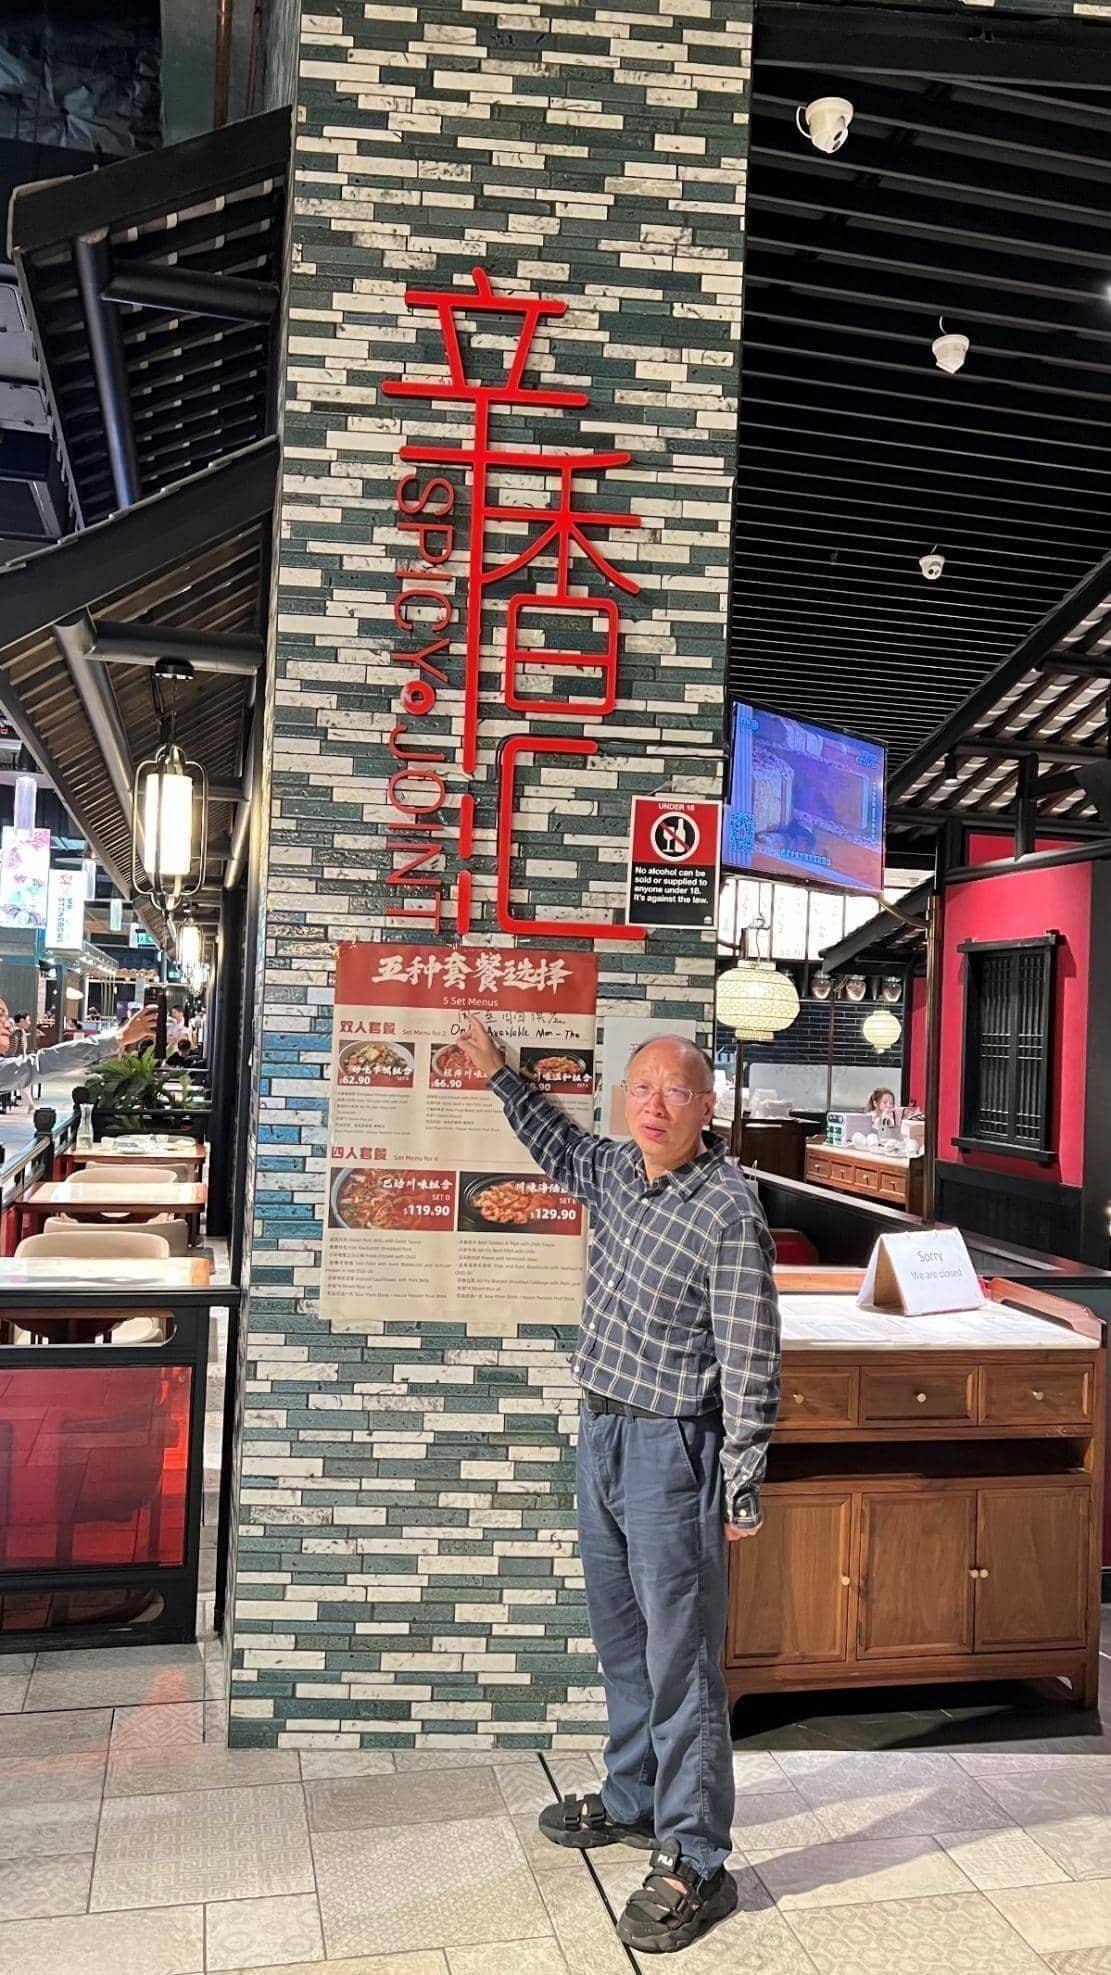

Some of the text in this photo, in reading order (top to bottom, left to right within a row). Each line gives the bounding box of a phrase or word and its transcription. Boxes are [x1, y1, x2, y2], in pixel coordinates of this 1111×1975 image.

[385, 473, 455, 934] SPICY JOINT
[658, 802, 695, 811] UNDER 18
[635, 866, 706, 877] No alcohol can be
[634, 876, 652, 884] sold
[663, 877, 698, 886] supplied
[699, 878, 708, 886] to
[634, 886, 663, 894] anyone
[664, 886, 689, 894] under
[646, 895, 676, 904] against
[677, 895, 691, 904] the
[692, 896, 709, 904] law.
[371, 951, 574, 995] 五种套餐选择
[442, 996, 499, 1008] 5 Set Menus
[339, 1019, 396, 1036] 双人套餐
[331, 1146, 388, 1161] 四人套餐
[393, 1153, 404, 1161] Set
[405, 1153, 423, 1162] Menu
[424, 1154, 433, 1162] for
[431, 1193, 444, 1201] SET
[403, 1203, 451, 1217] $119.90
[530, 1207, 577, 1220] $129.90
[918, 1250, 944, 1264] Sorry
[910, 1268, 963, 1281] We are closed
